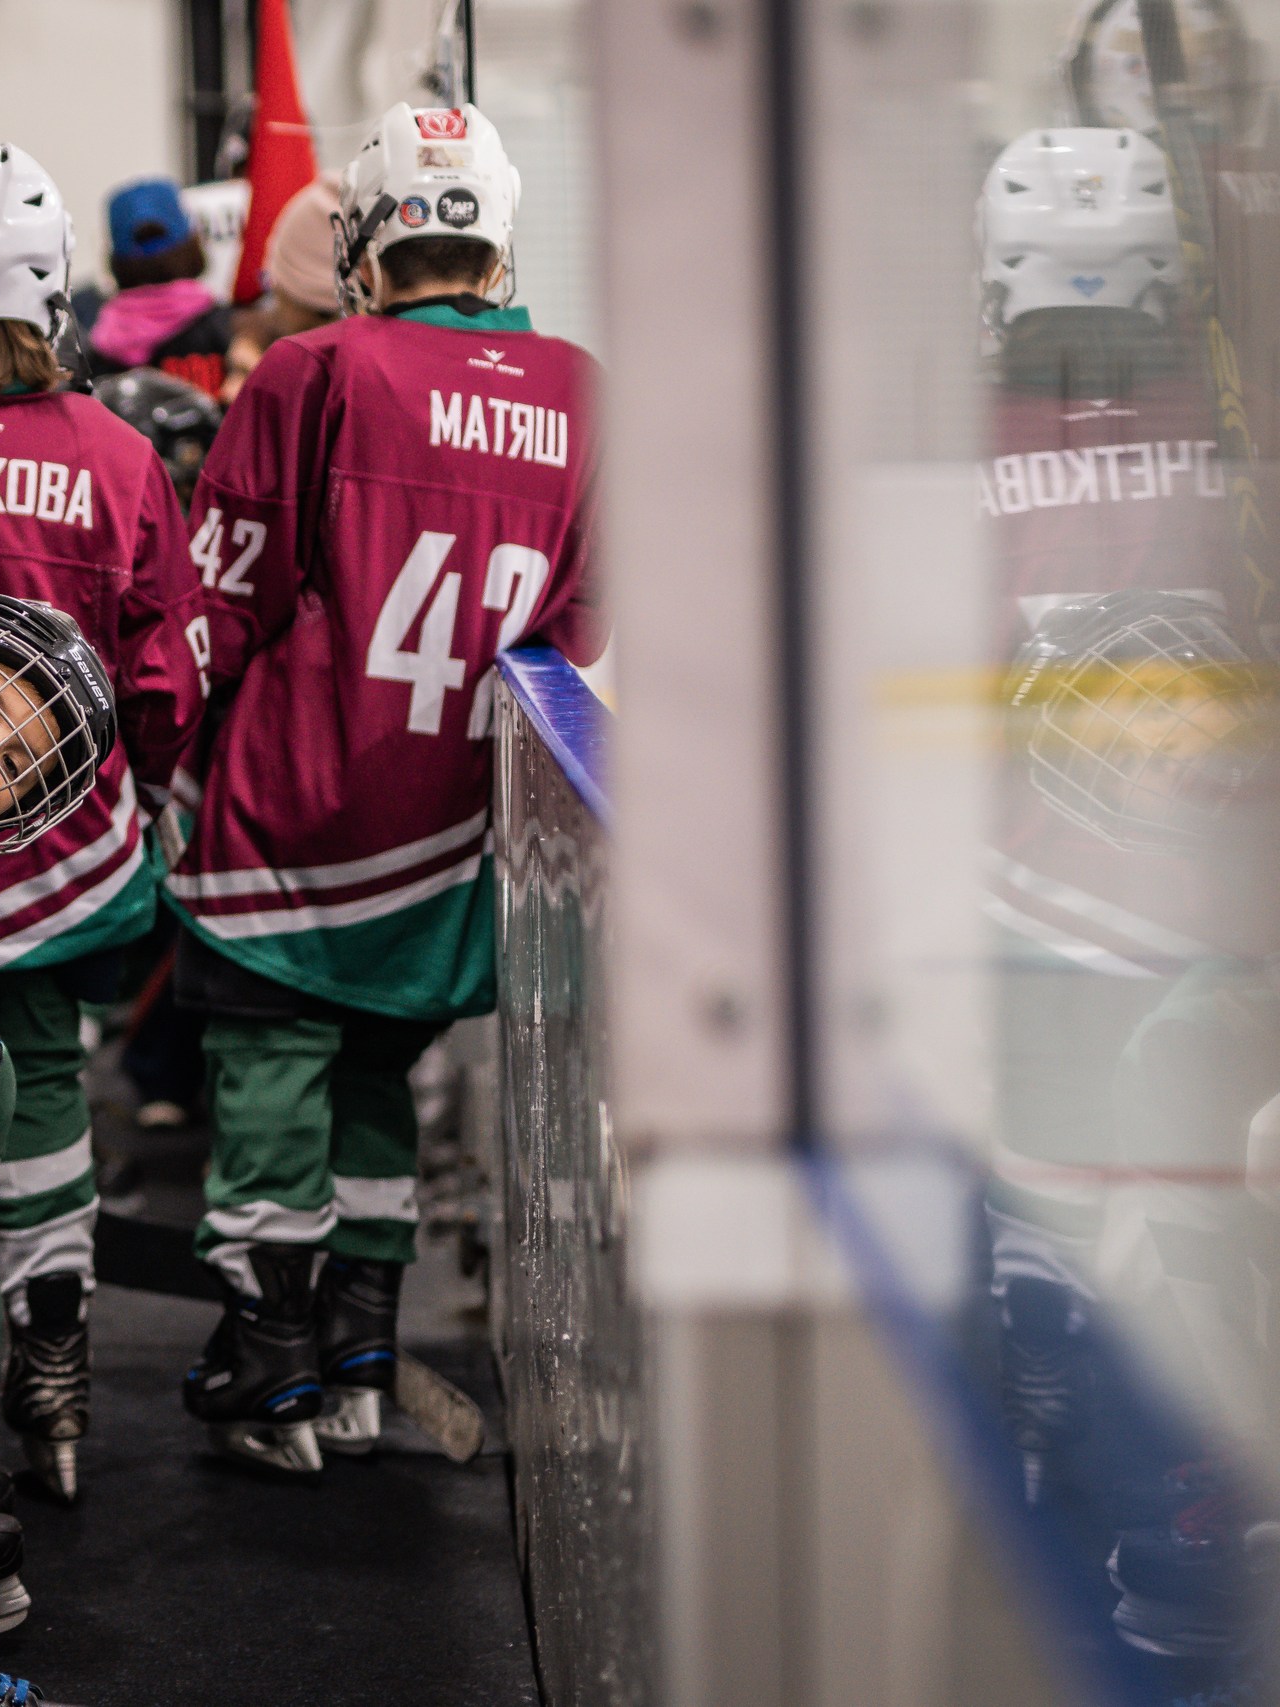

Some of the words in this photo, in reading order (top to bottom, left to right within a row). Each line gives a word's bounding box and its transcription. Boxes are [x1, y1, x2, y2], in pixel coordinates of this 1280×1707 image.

[429, 389, 568, 469] МАТЯШ
[189, 507, 268, 597] 42
[366, 531, 550, 741] 42
[69, 649, 110, 711] BAUER
